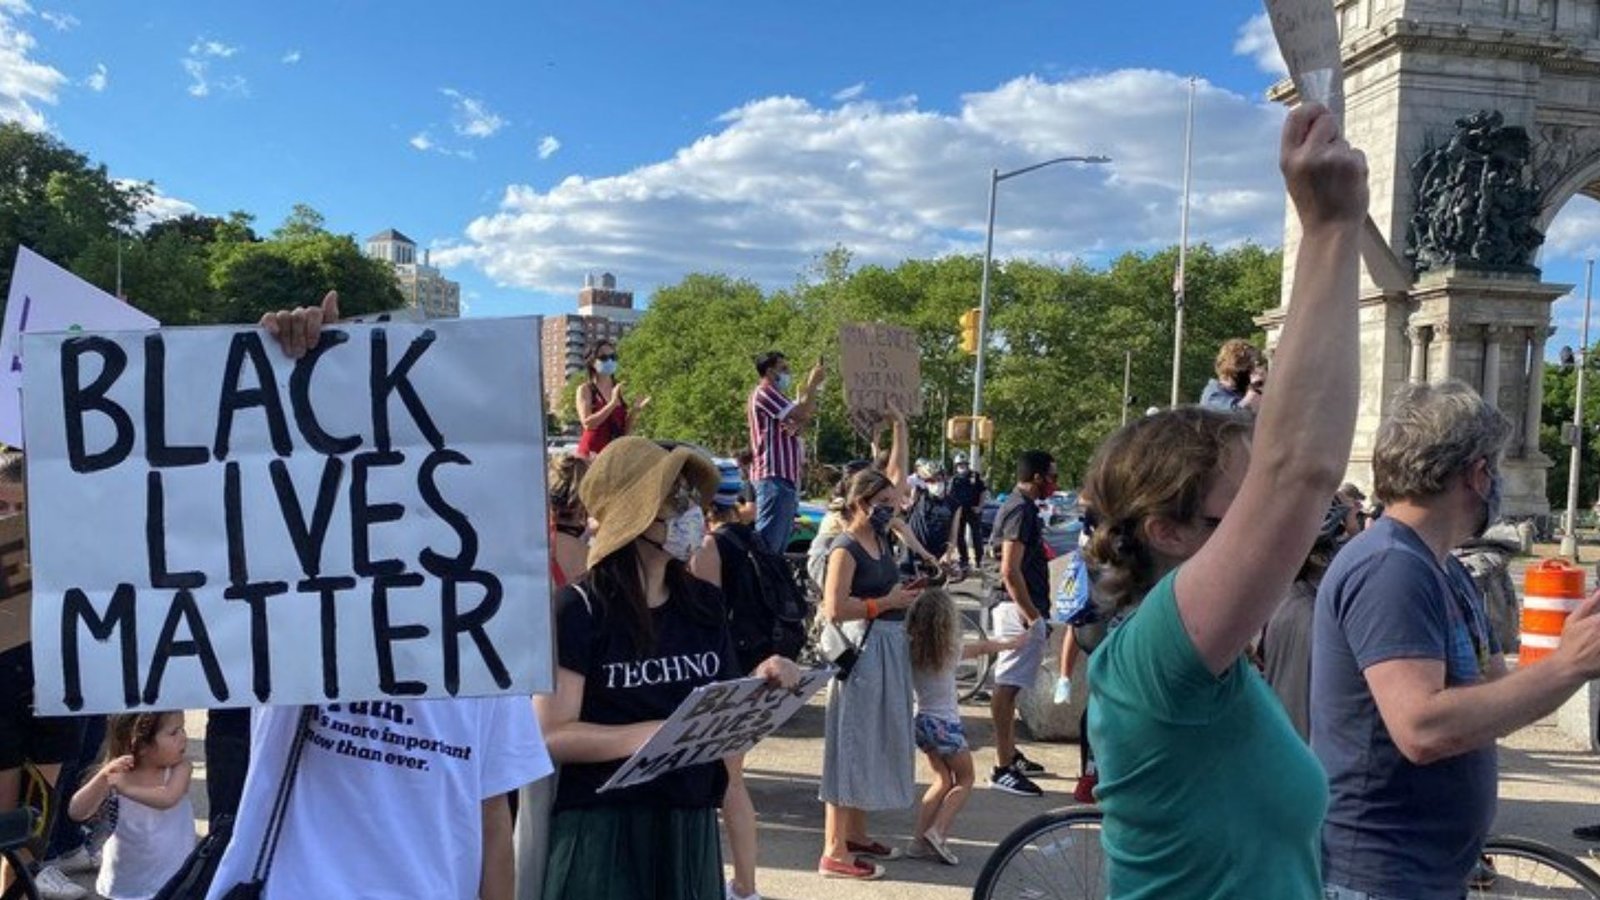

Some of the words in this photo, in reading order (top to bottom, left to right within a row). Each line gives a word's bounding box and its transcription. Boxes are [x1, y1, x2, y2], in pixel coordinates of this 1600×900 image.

[853, 371, 881, 388] NOT
[884, 371, 907, 389] AN
[868, 351, 889, 369] IS
[61, 328, 445, 473] BLACK
[146, 449, 479, 590] LIVES
[61, 569, 512, 711] MATTER
[602, 651, 721, 688] TECHNO
[681, 676, 816, 721] BLACK
[330, 719, 380, 740] more
[380, 726, 472, 761] important
[673, 708, 773, 744] LIVES
[336, 739, 383, 763] than
[384, 754, 430, 772] ever.
[617, 723, 775, 783] MATTER
